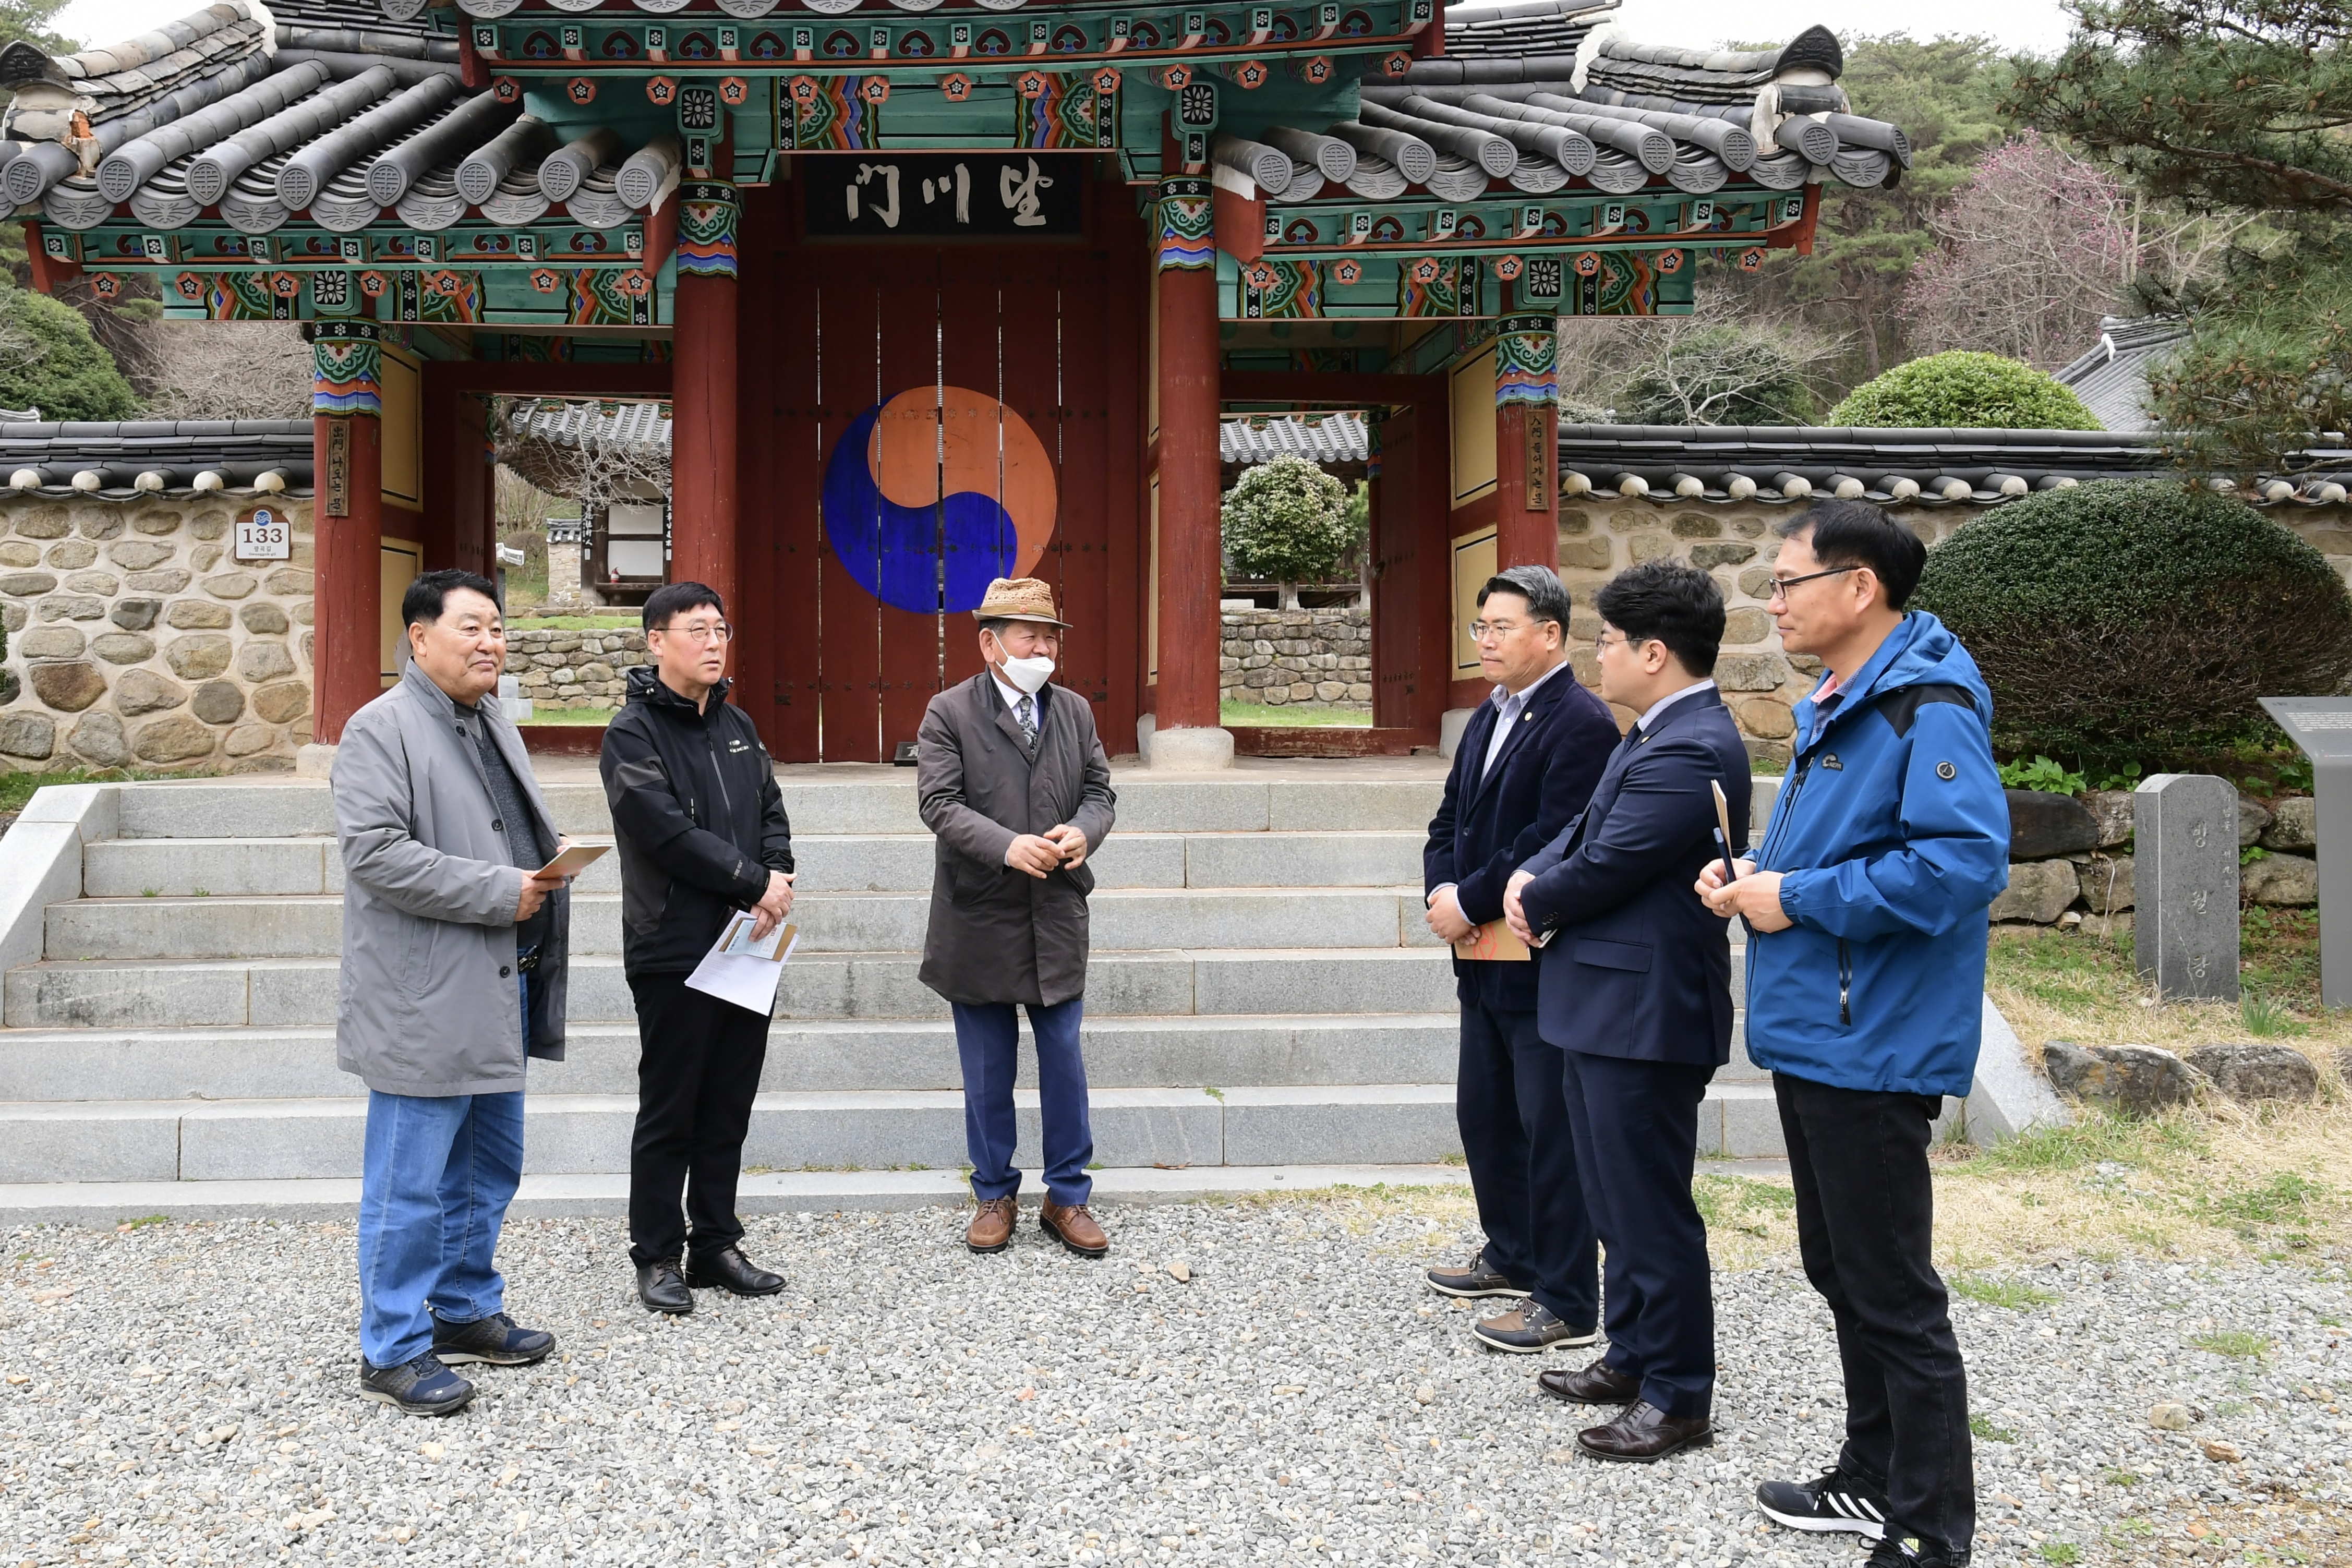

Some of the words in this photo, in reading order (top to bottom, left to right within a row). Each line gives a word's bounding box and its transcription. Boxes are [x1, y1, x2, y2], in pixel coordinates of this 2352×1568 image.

[1530, 416, 1542, 438] 入門
[332, 426, 344, 451] 出門
[243, 528, 283, 544] 133
